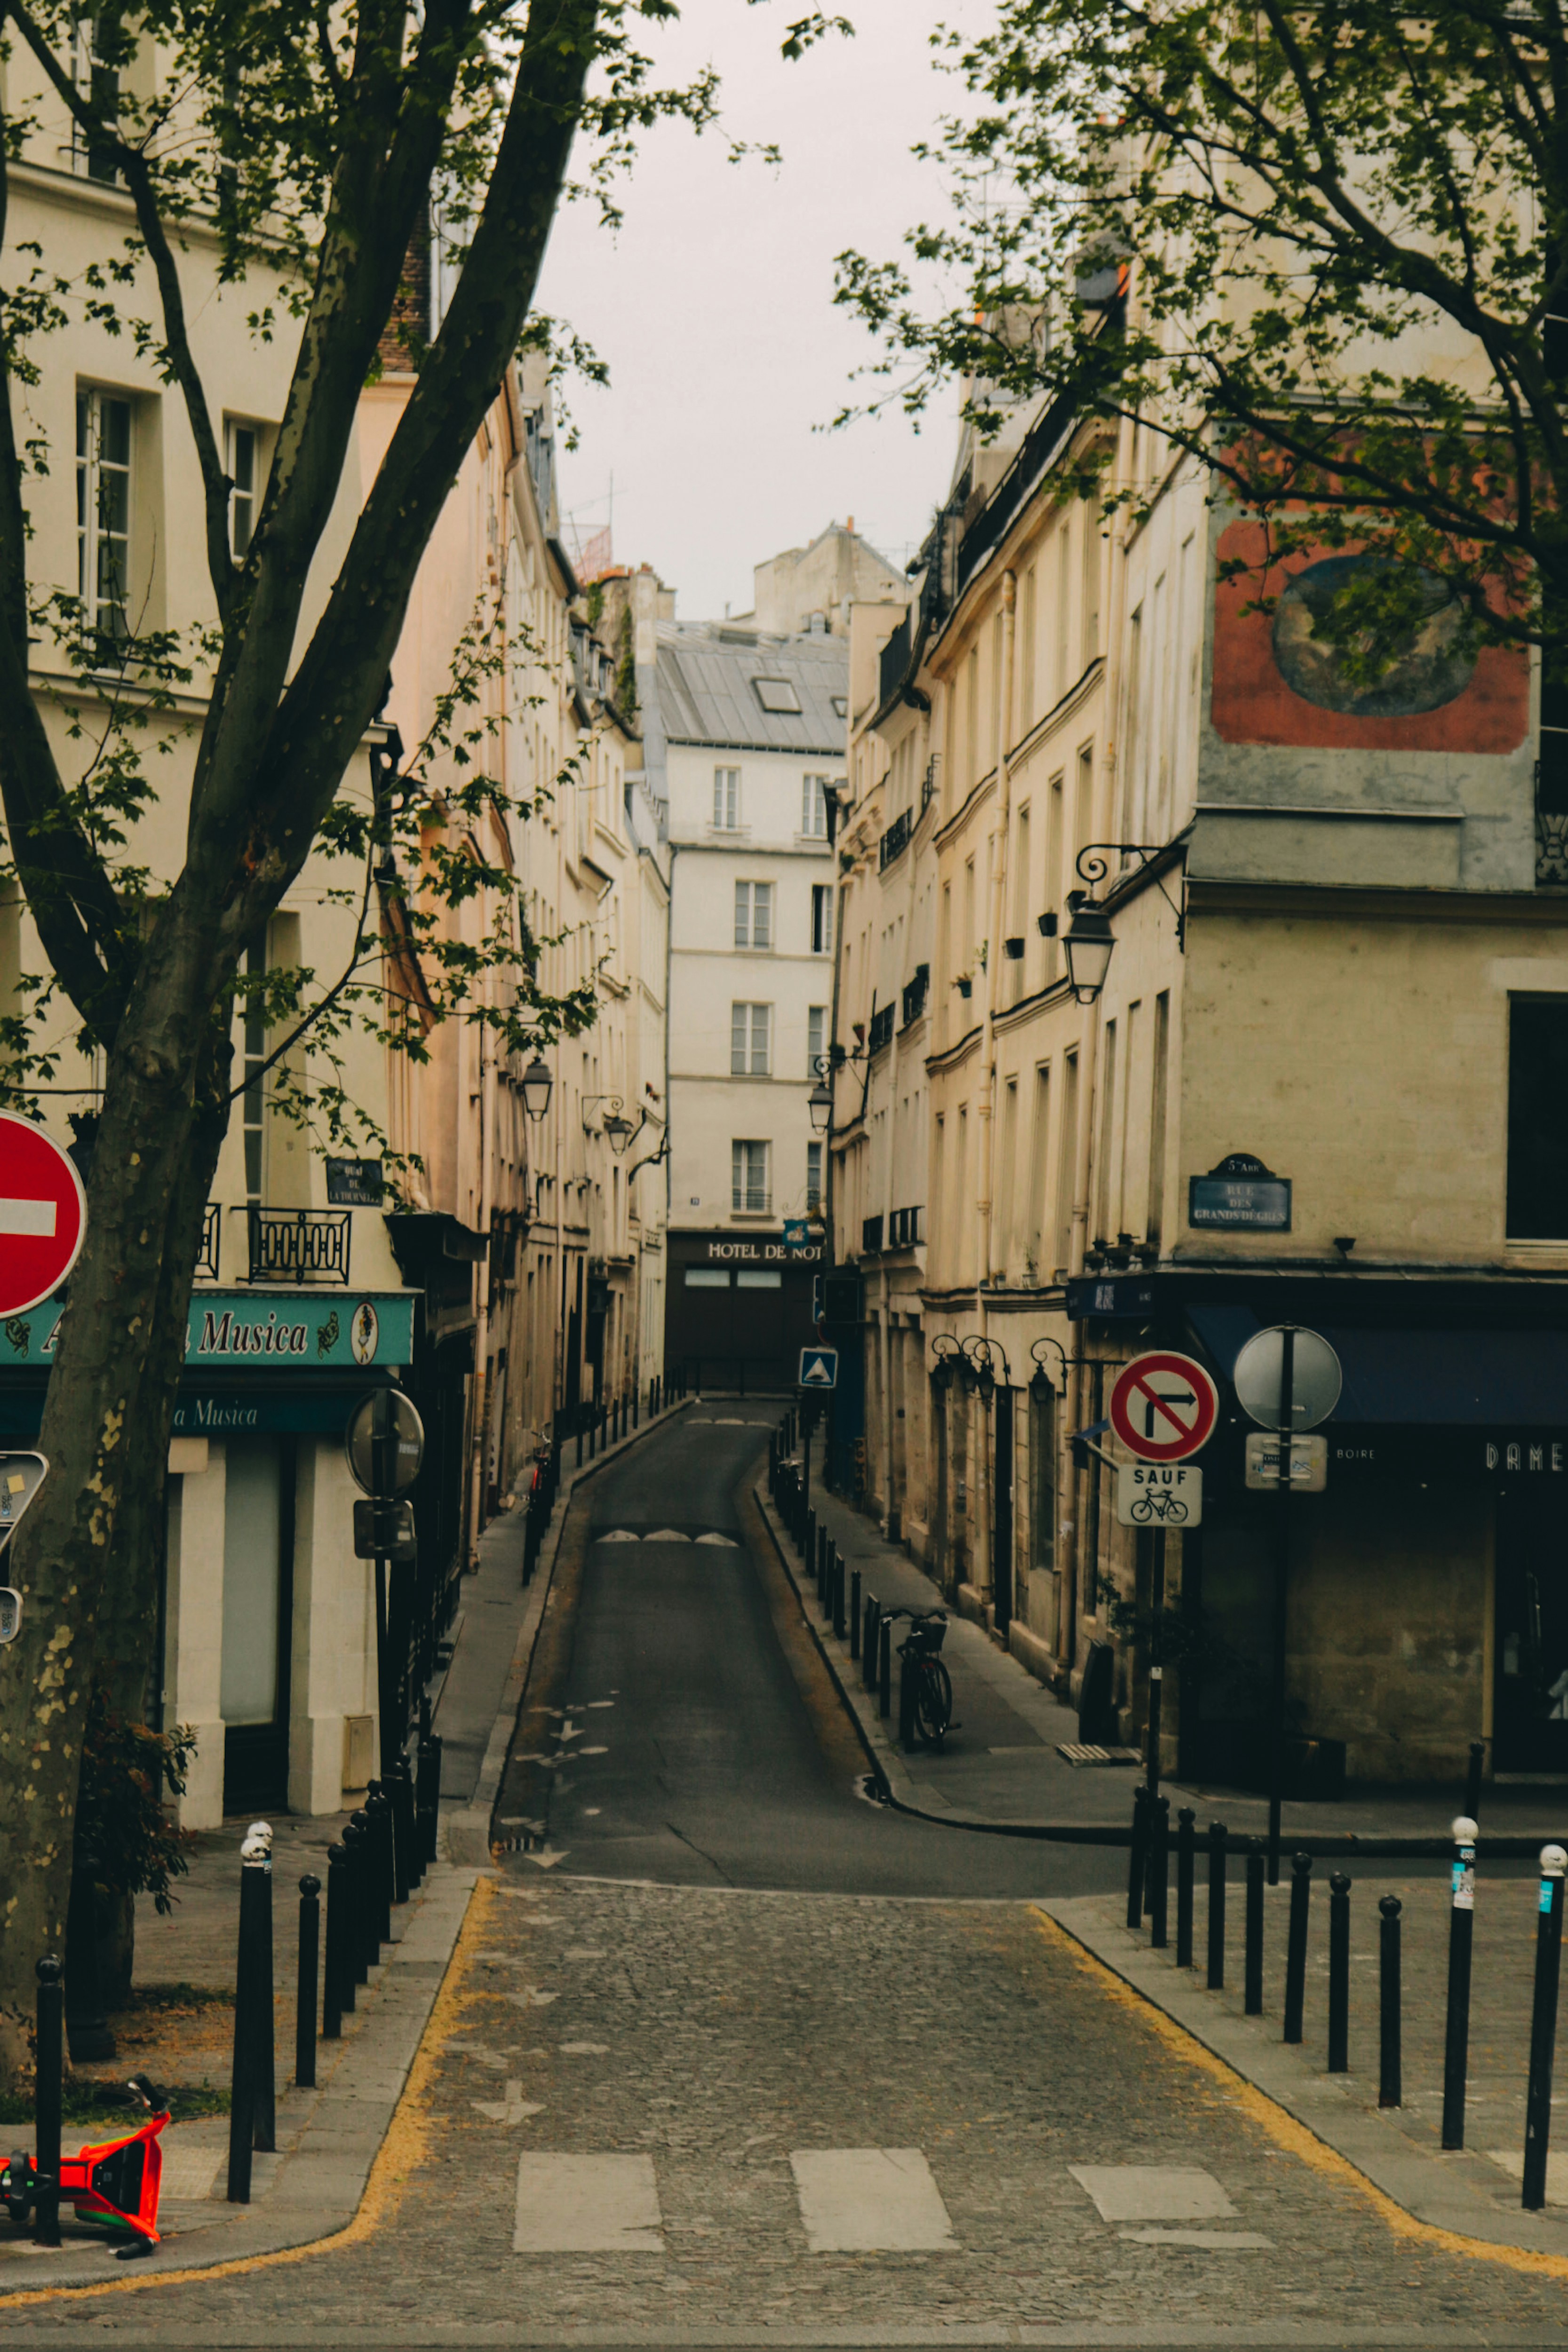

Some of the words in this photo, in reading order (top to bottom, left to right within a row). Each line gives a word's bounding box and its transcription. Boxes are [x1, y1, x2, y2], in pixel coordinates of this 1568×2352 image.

[1227, 1185, 1254, 1196] RUE
[1229, 1199, 1251, 1208] DES
[709, 1243, 759, 1259] HOTEL
[765, 1244, 787, 1259] DE
[198, 1311, 308, 1355] Musica
[193, 1399, 258, 1426] Musica
[1337, 1449, 1375, 1459] BOIRE
[1486, 1442, 1564, 1471] DAME
[1134, 1470, 1187, 1484] SAUF
